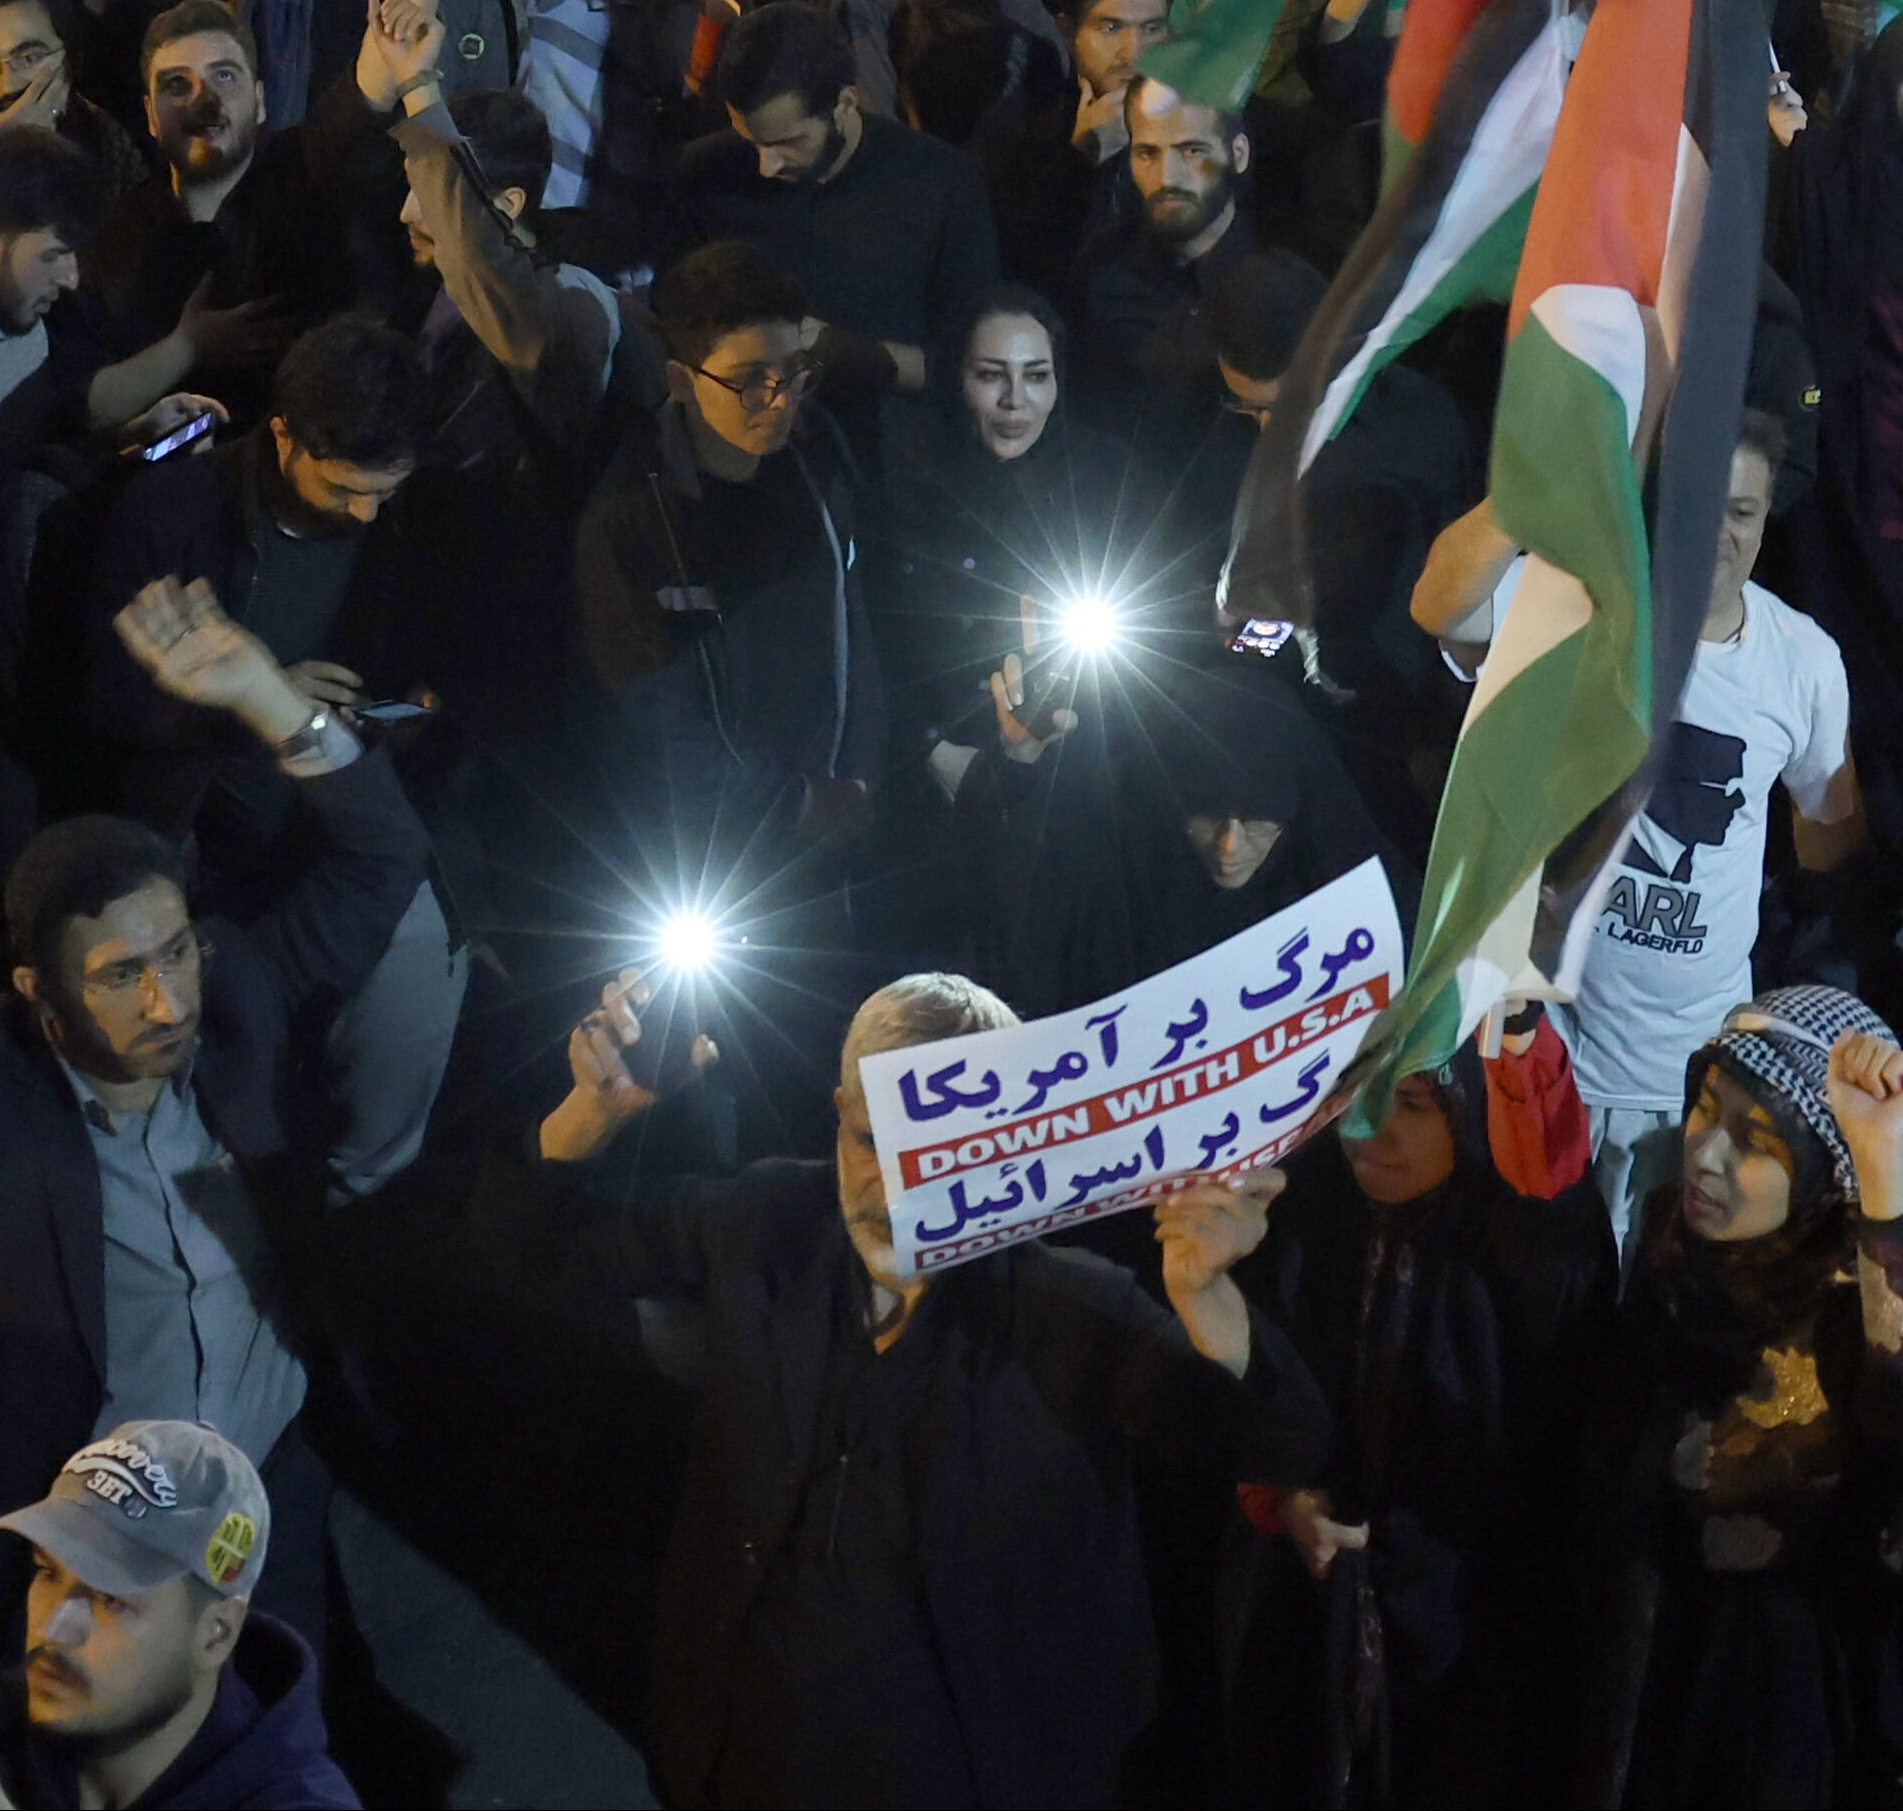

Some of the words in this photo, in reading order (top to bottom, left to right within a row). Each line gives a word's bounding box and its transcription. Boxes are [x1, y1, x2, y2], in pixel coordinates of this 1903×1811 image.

[1600, 875, 1708, 939] ARL
[1240, 926, 1374, 1011] مرگ
[898, 1003, 1128, 1122] آمریکا
[1150, 998, 1208, 1070] بر
[917, 1105, 1090, 1180] DOWN
[1103, 1050, 1240, 1124] WITH
[1253, 987, 1374, 1064] U.S.A
[1195, 1111, 1240, 1169] بر
[915, 1123, 1164, 1242] اسرائیل
[921, 1206, 1087, 1267] DOWN
